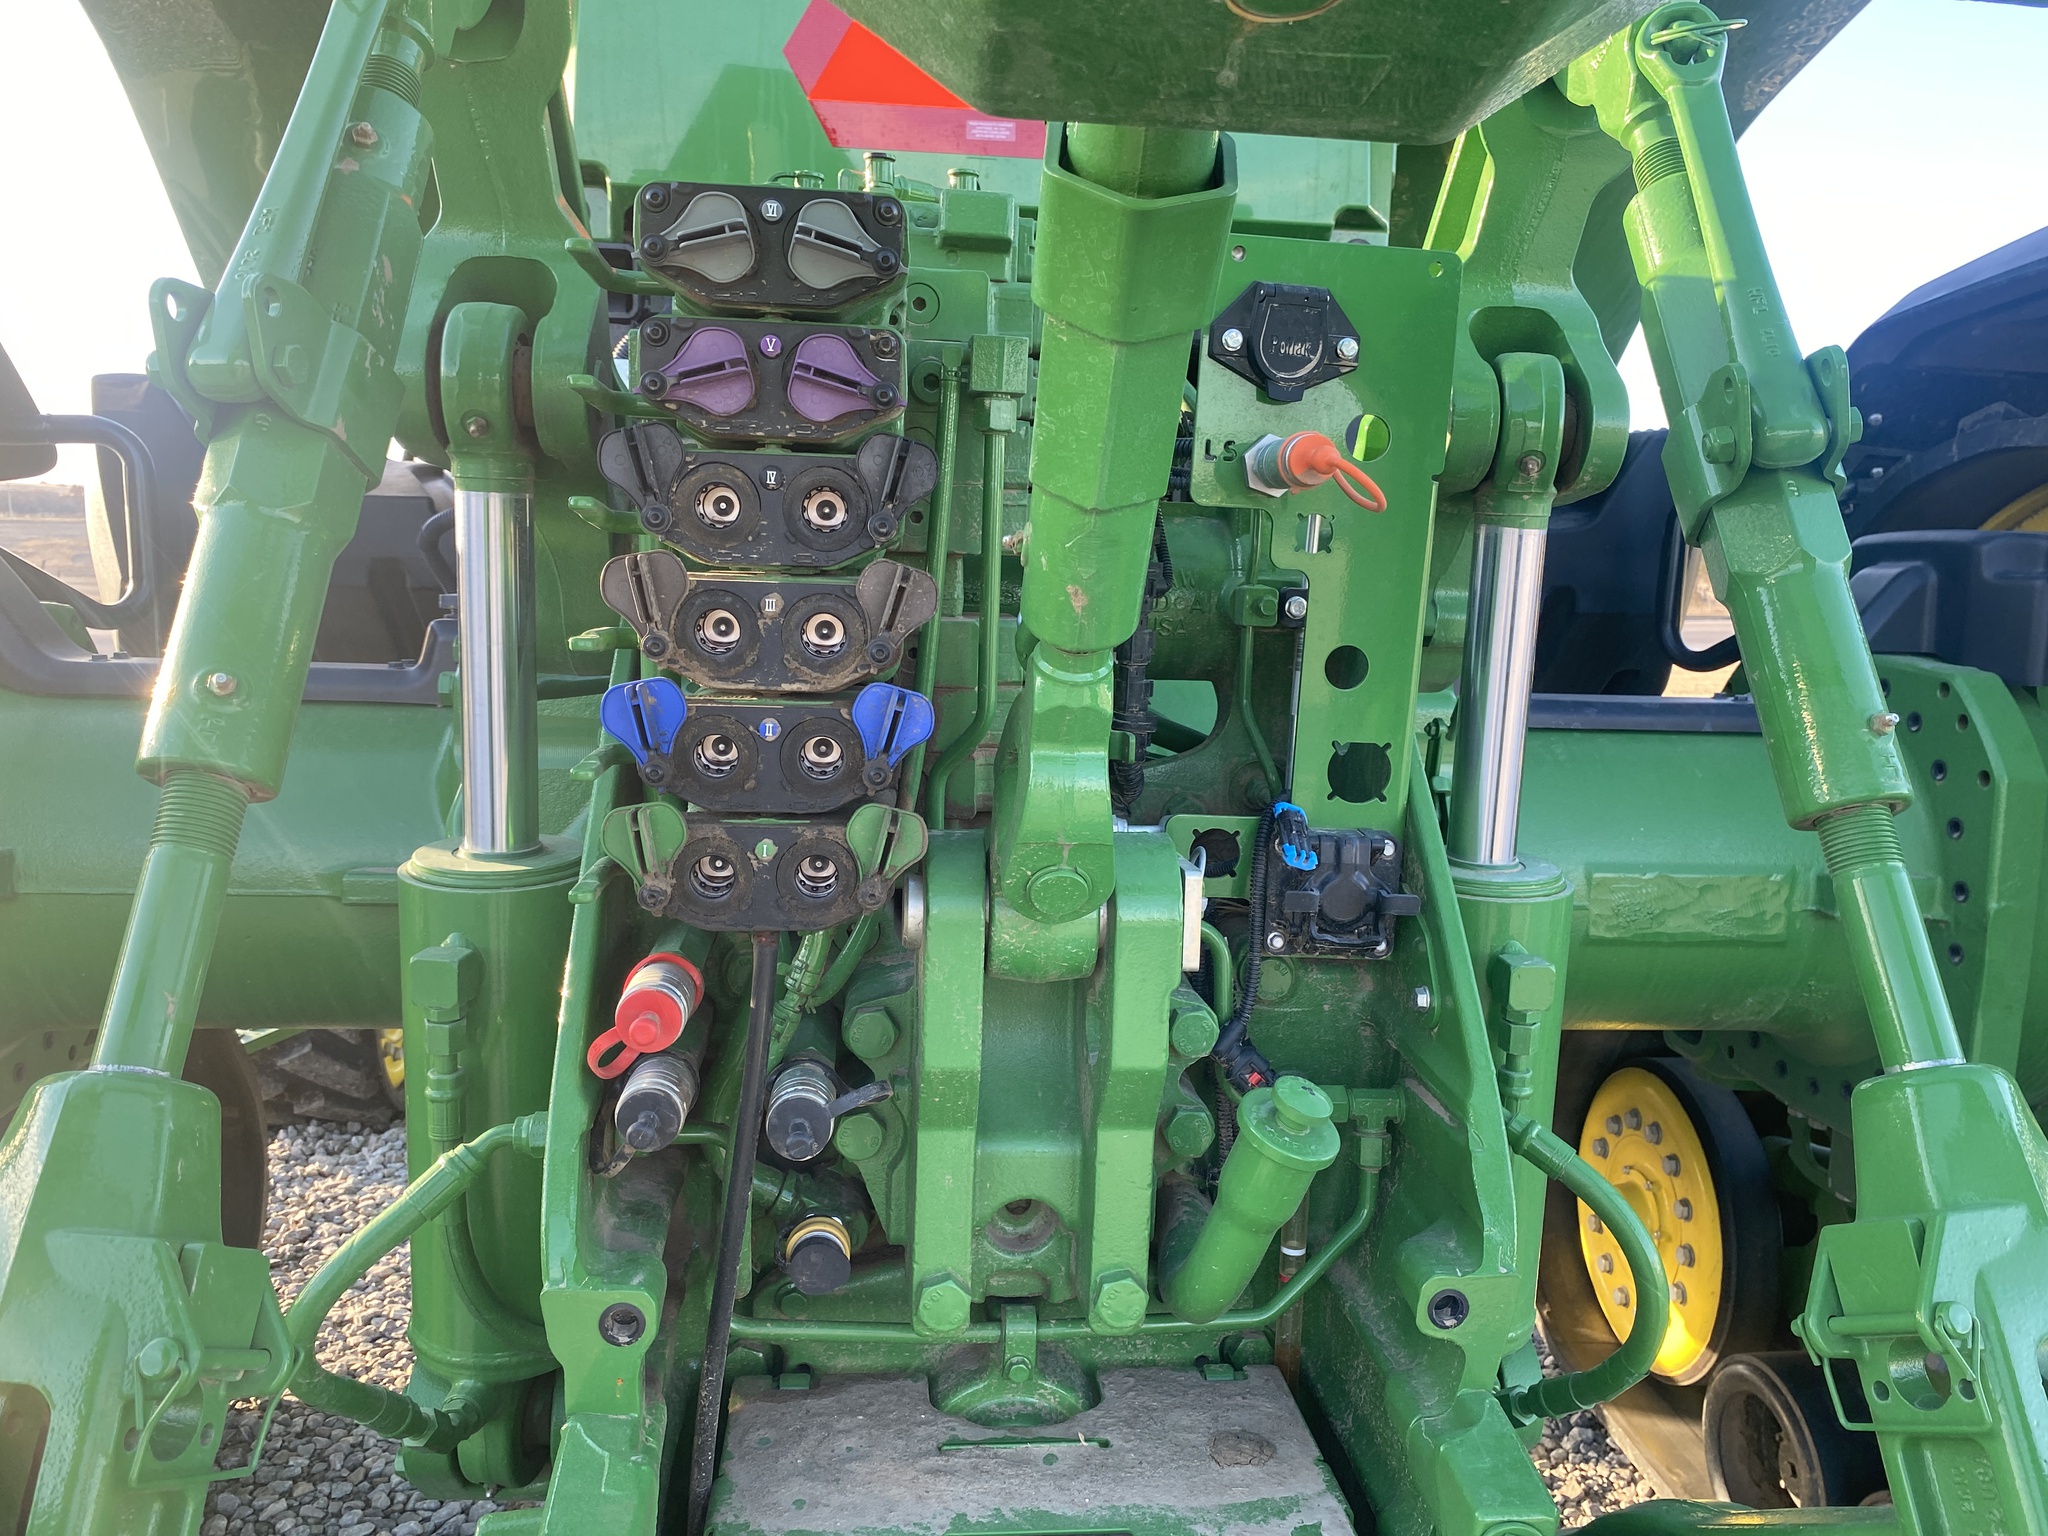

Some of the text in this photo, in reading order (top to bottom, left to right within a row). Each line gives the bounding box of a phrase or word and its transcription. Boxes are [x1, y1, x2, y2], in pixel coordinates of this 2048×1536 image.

[766, 202, 778, 217] VI
[765, 337, 777, 352] V
[766, 470, 777, 484] IV
[765, 598, 776, 612] III
[764, 723, 774, 737] II
[762, 844, 768, 857] I
